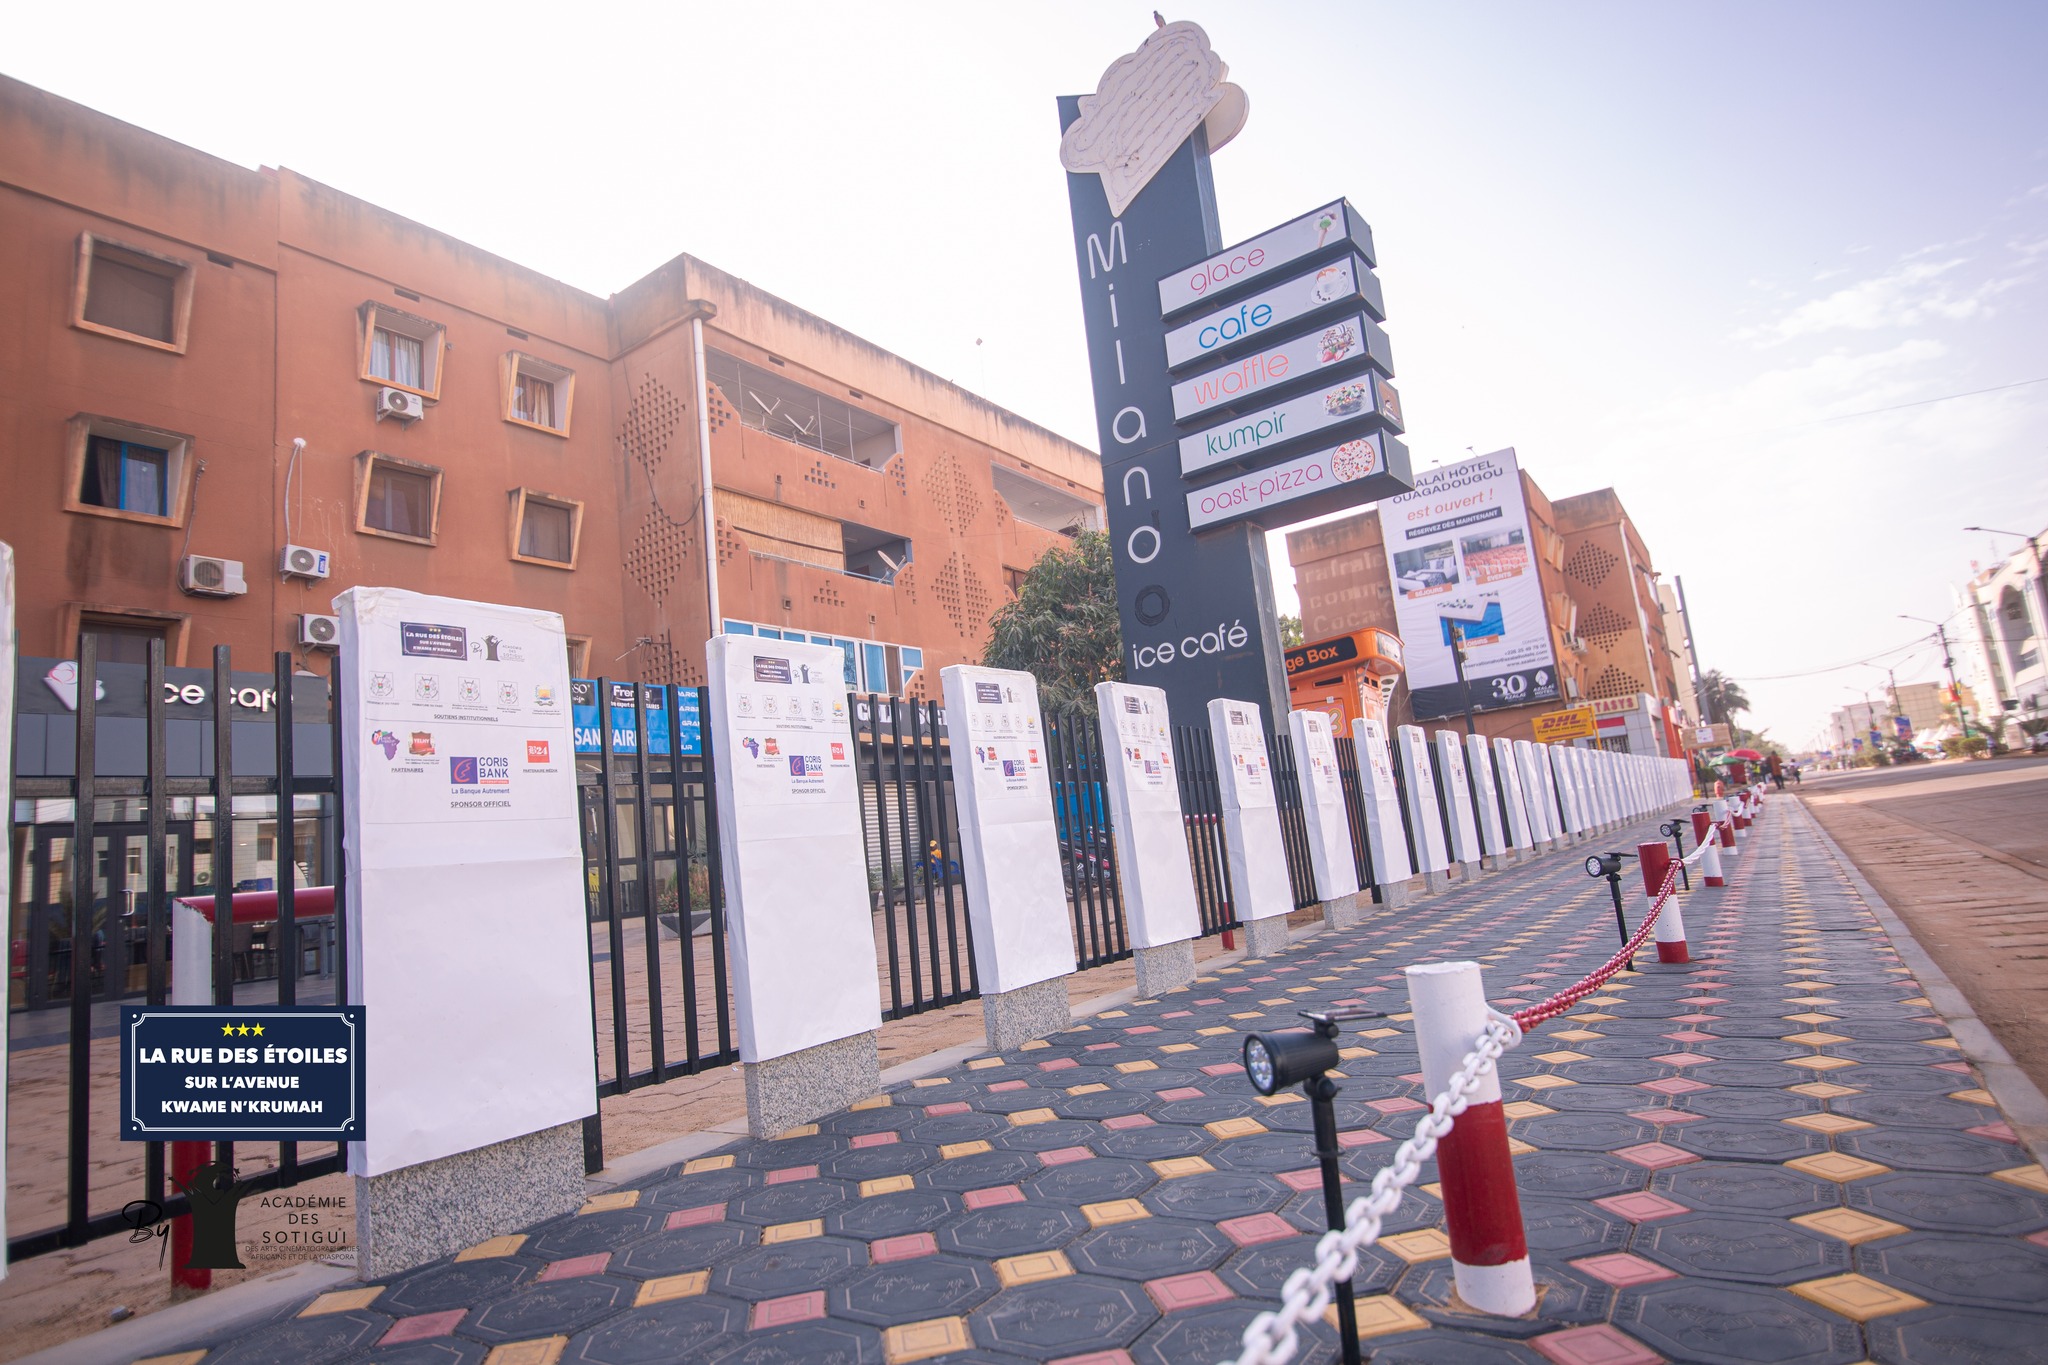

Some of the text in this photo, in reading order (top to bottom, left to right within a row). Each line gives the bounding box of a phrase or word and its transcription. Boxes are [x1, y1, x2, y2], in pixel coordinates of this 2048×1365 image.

[1190, 248, 1265, 295] glace
[1198, 303, 1273, 349] cafe
[1193, 353, 1289, 405] waffle
[1206, 411, 1287, 456] kumpir
[1392, 467, 1503, 504] OUAGADOUGOU
[1413, 459, 1495, 488] ALAÏ HÔTEL
[1200, 463, 1324, 514] oast-pizza
[1407, 505, 1430, 521] est
[1434, 491, 1485, 514] ouvert
[1456, 510, 1499, 526] MAINTENANT
[1132, 619, 1248, 670] ice café
[1306, 646, 1339, 664] Box
[1491, 674, 1528, 698] 30
[433, 714, 499, 723] SOUTIENS INSTITUTIONNELS
[1541, 713, 1581, 729] DHL
[479, 756, 508, 767] CORIS
[479, 768, 509, 778] BANK
[805, 755, 821, 763] CORIS
